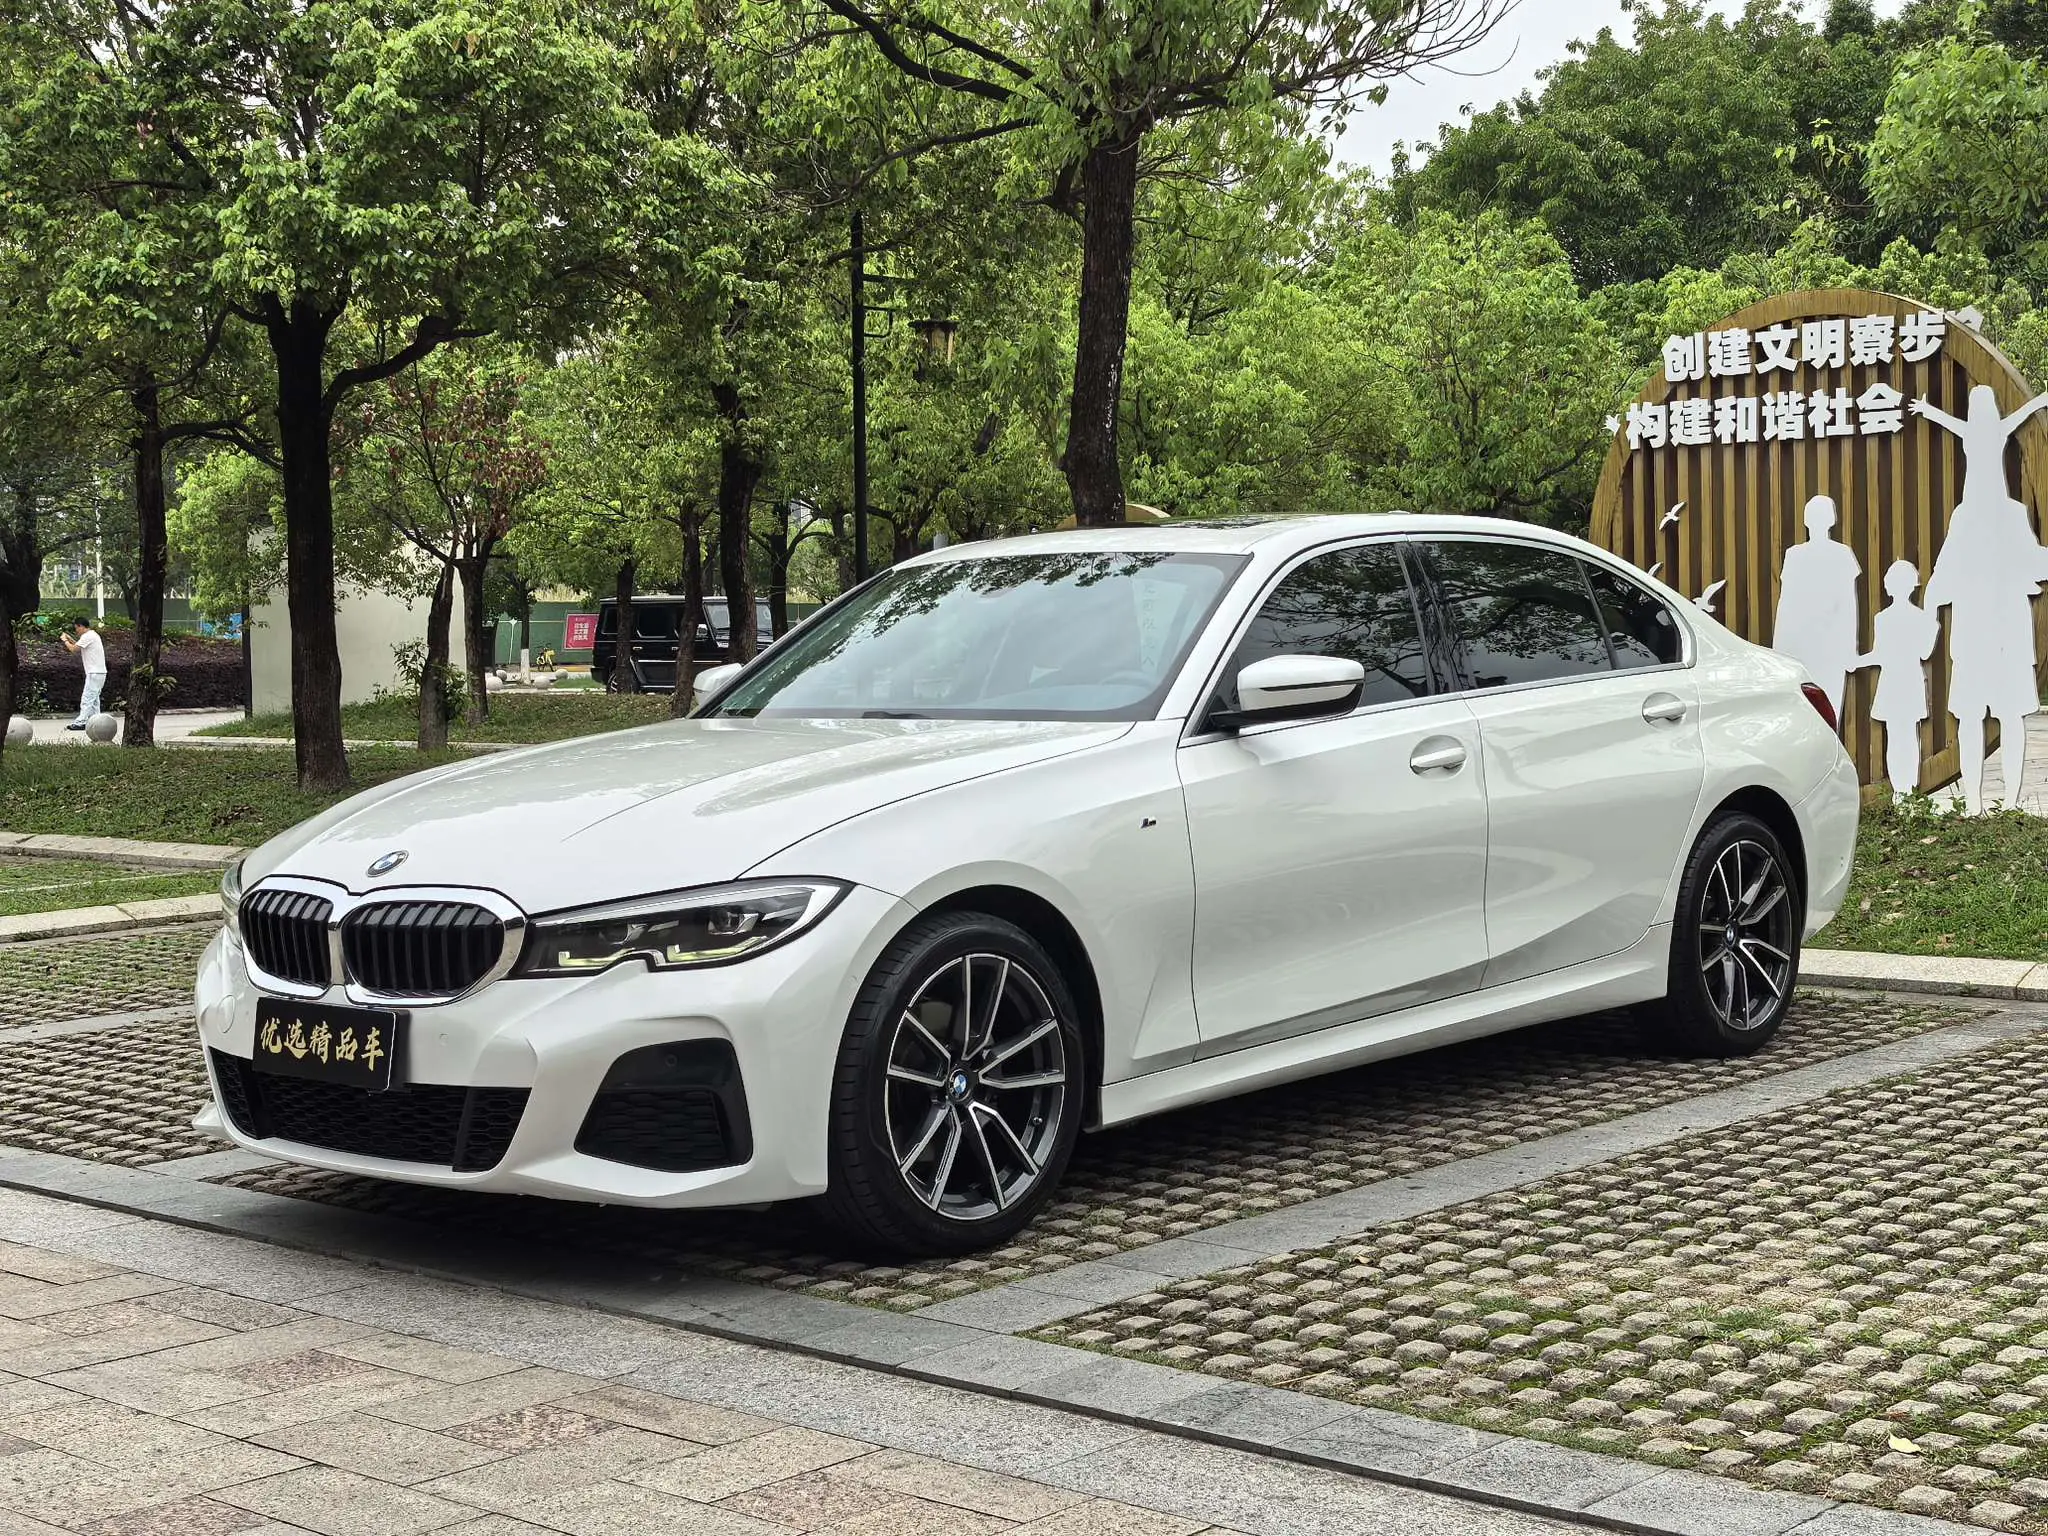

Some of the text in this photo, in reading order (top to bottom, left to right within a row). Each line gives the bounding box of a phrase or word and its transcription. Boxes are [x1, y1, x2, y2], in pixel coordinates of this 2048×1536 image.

[1661, 308, 1946, 382] 创建文明寮步
[1625, 382, 1904, 450] 构建和谐社会
[260, 1017, 384, 1071] 优选精品车
